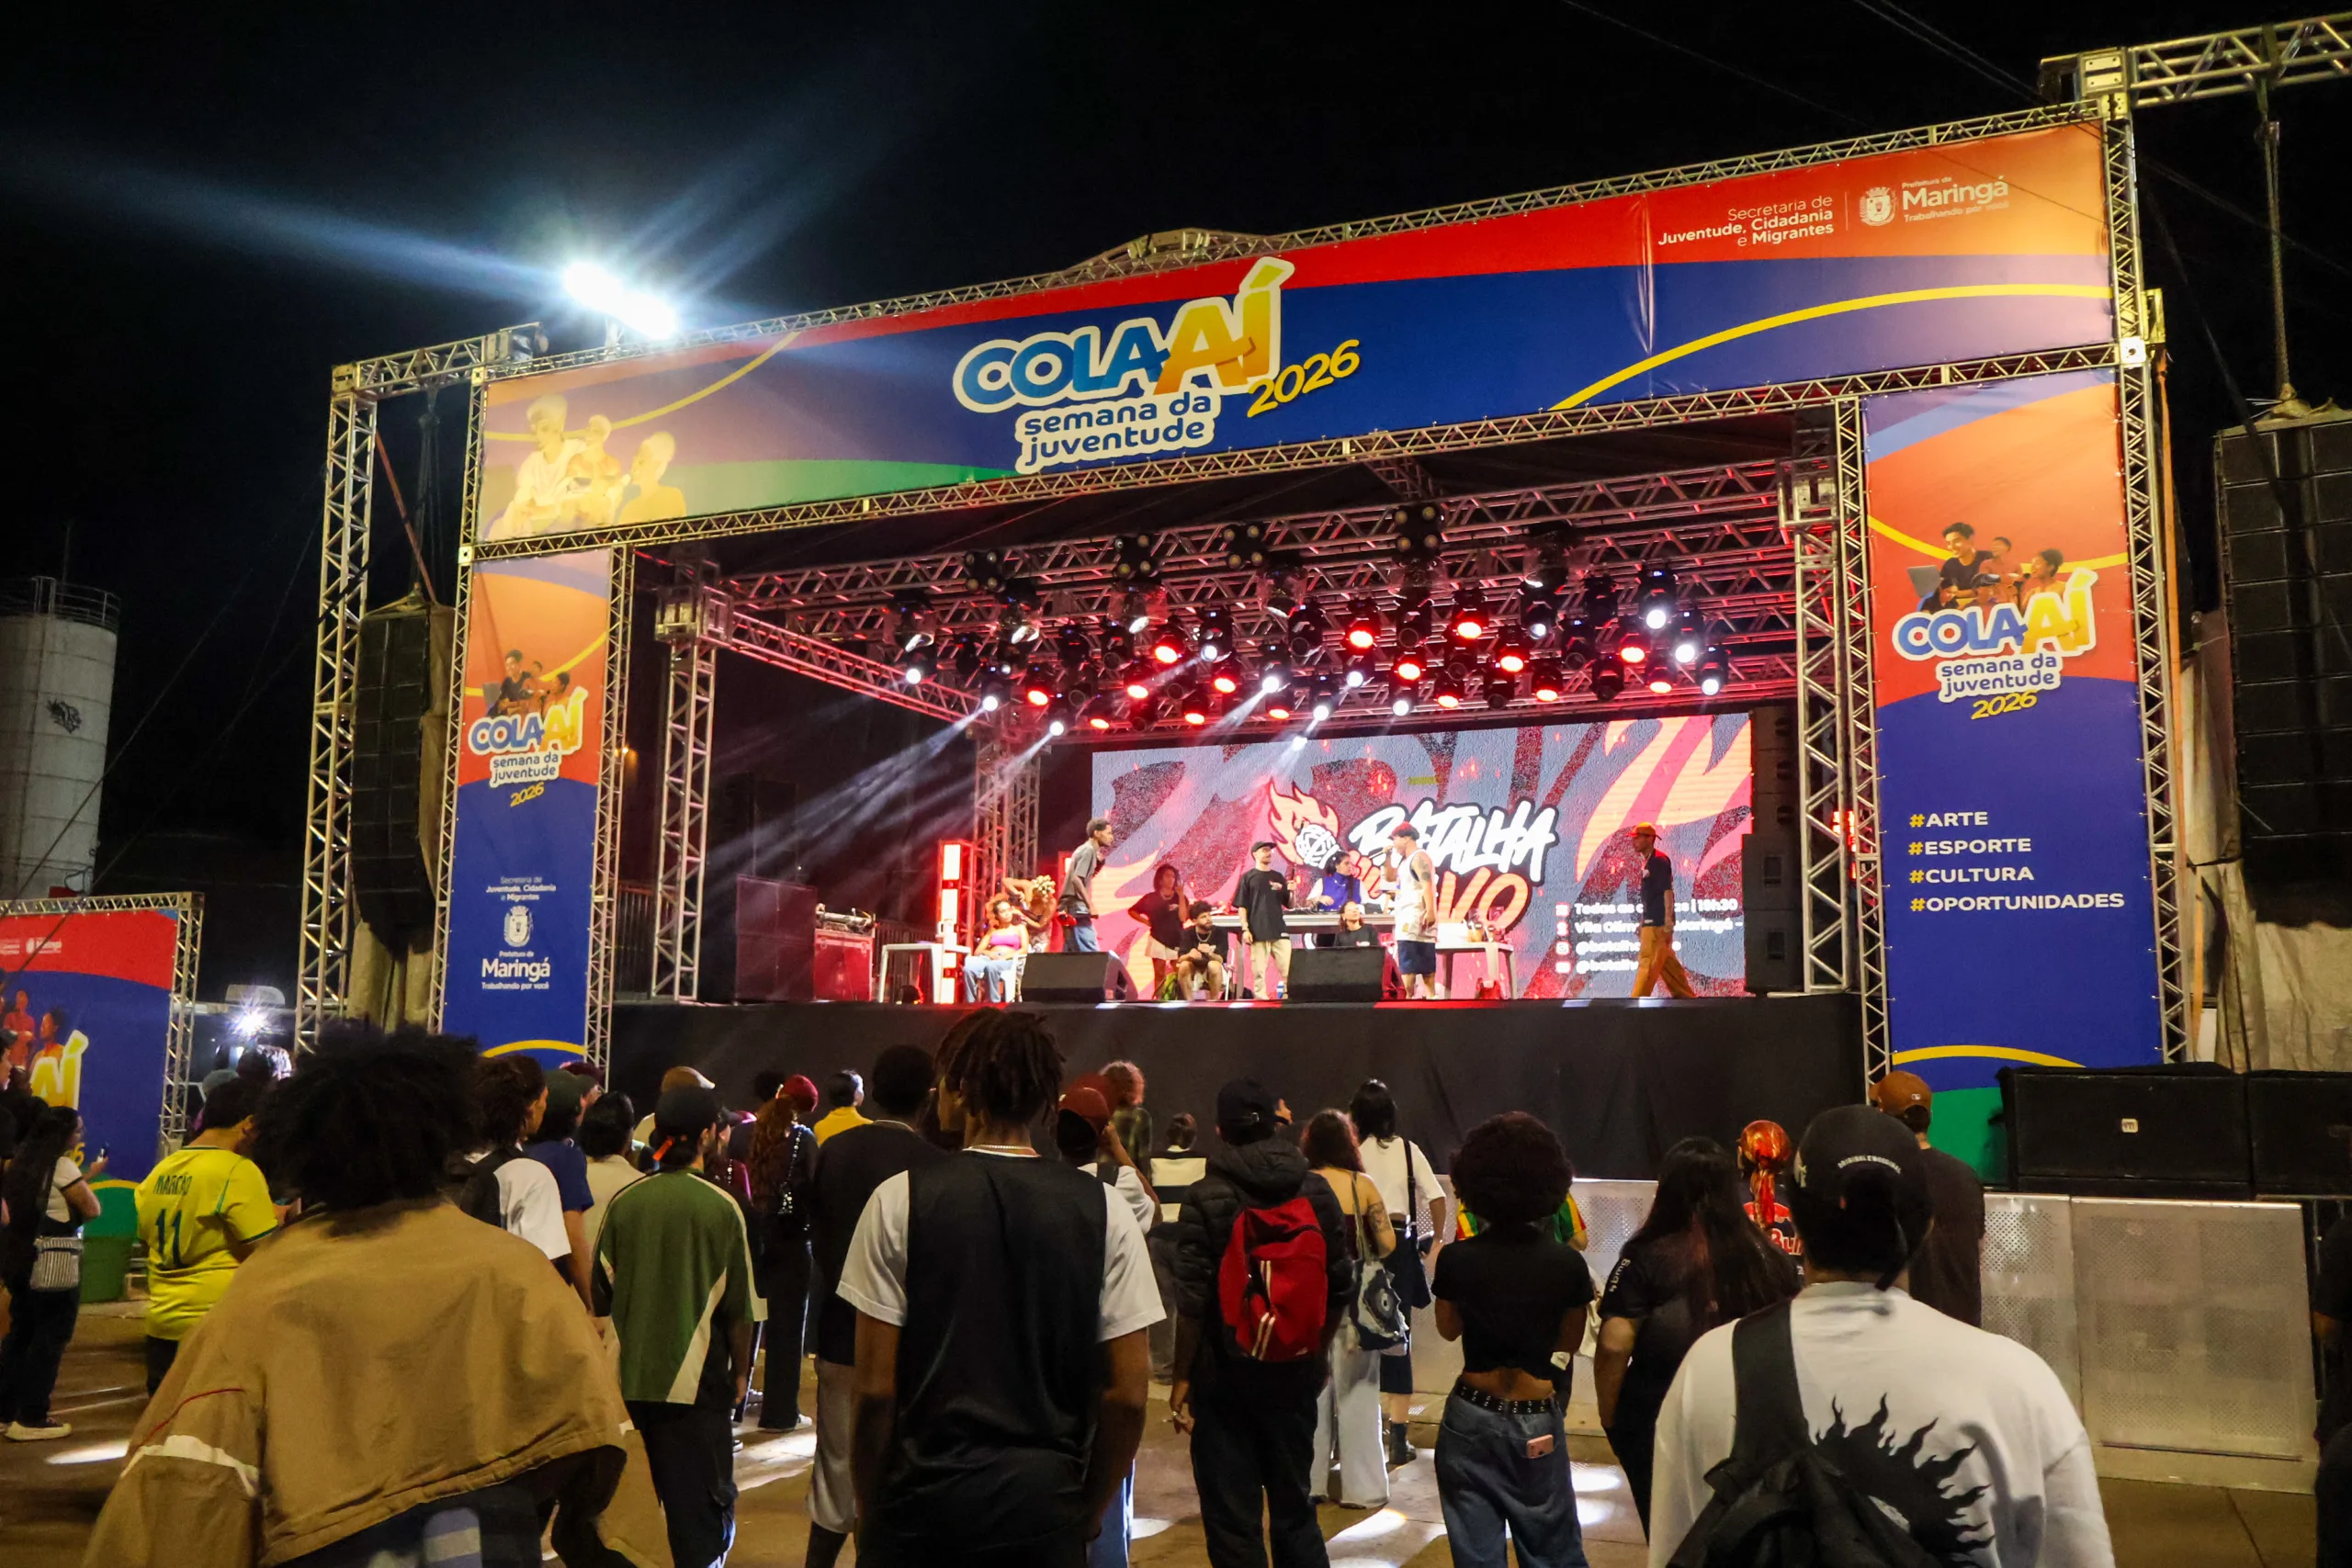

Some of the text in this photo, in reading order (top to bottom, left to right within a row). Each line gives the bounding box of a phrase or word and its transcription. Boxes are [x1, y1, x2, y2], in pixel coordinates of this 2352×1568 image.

[1903, 175, 2009, 210] Maringá
[1728, 195, 1833, 221] Secretaria de
[1658, 209, 1834, 246] Juventude, Cidadania
[1737, 223, 1834, 247] e Migrantes
[1247, 339, 1360, 418] 2026
[1024, 391, 1211, 436] semana da
[1024, 417, 1205, 467] juventude
[1941, 653, 2057, 677] semana da
[1944, 671, 2054, 697] juventude
[1971, 690, 2037, 720] 2026
[493, 751, 559, 769] semana da
[493, 765, 556, 784] juventude
[510, 782, 545, 807] 2026
[1909, 811, 1988, 828] #ARTE
[1908, 838, 2032, 856] #ESPORTE
[1909, 866, 2034, 884] #CULTURA
[1910, 893, 2125, 912] #OPORTUNIDADES
[481, 957, 551, 982] Maringá
[155, 1208, 190, 1269] 11
[1610, 1258, 1632, 1284] bmg
